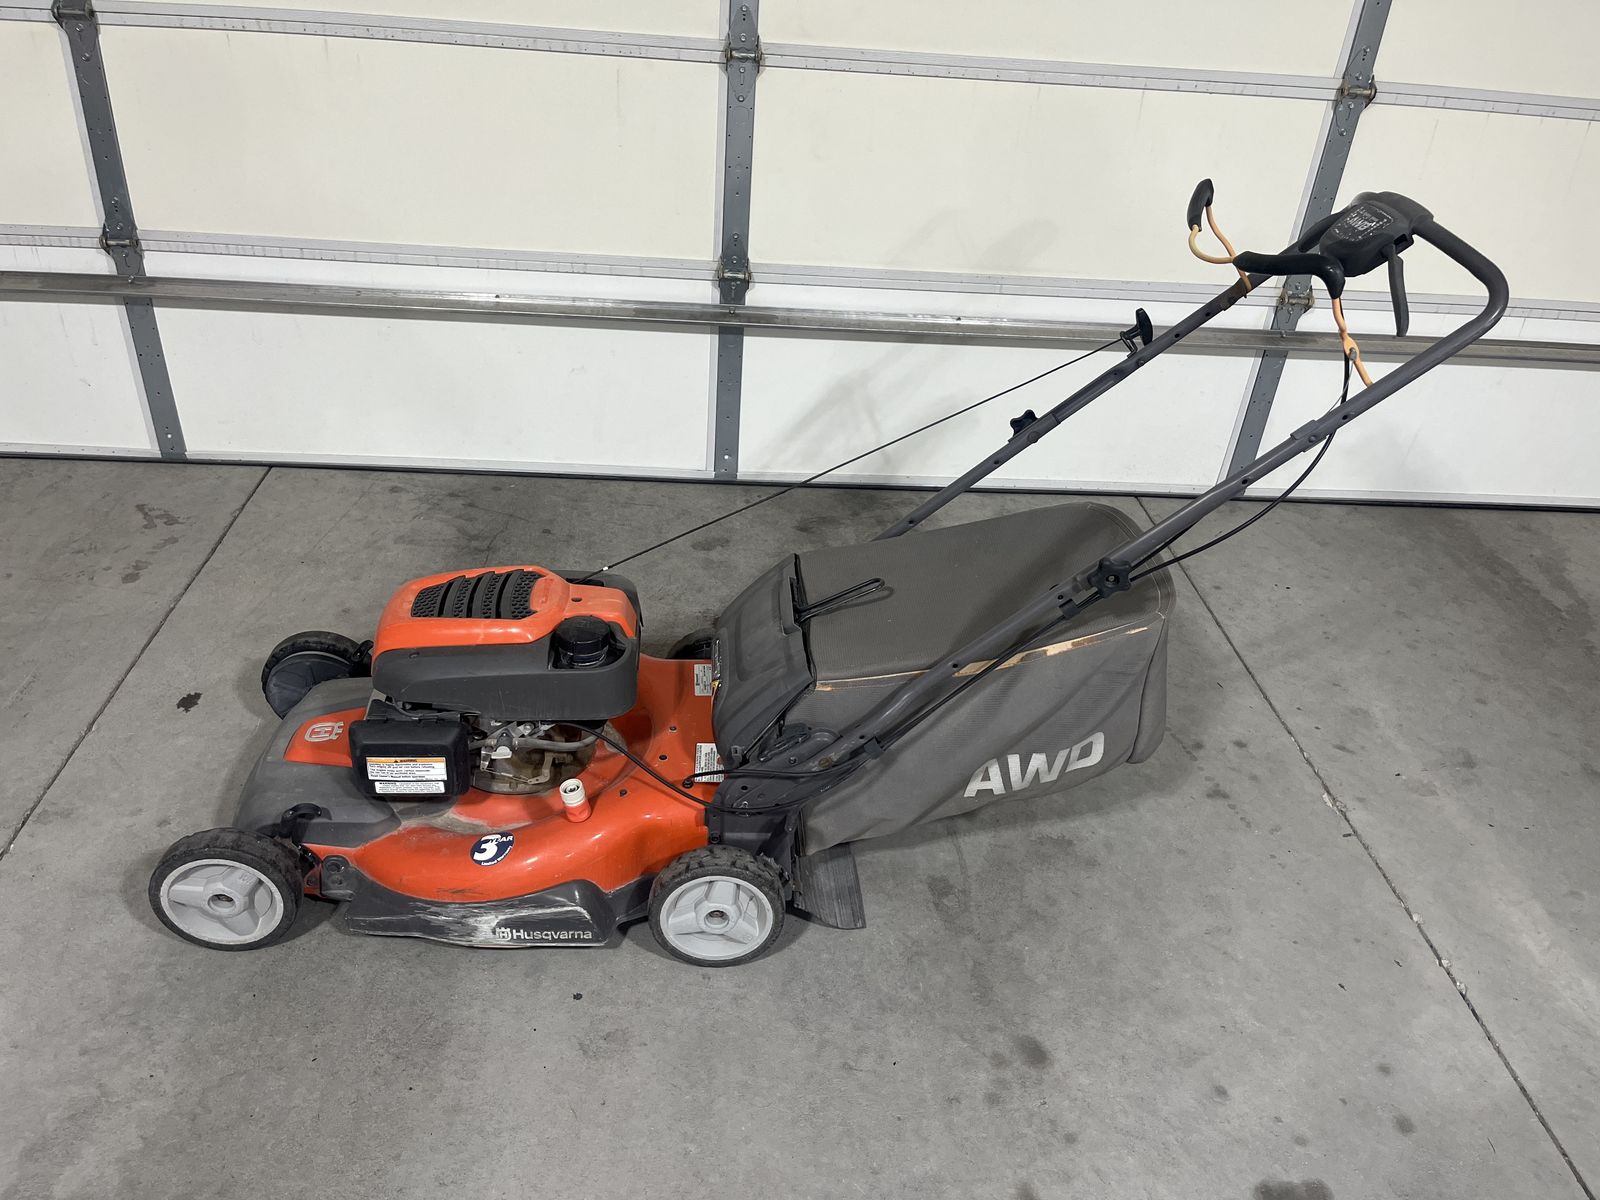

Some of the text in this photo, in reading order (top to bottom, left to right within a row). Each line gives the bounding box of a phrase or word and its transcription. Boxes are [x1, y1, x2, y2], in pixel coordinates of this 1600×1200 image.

[963, 731, 1105, 797] AWD
[473, 834, 501, 861] 3
[512, 929, 592, 940] Husqvarna
